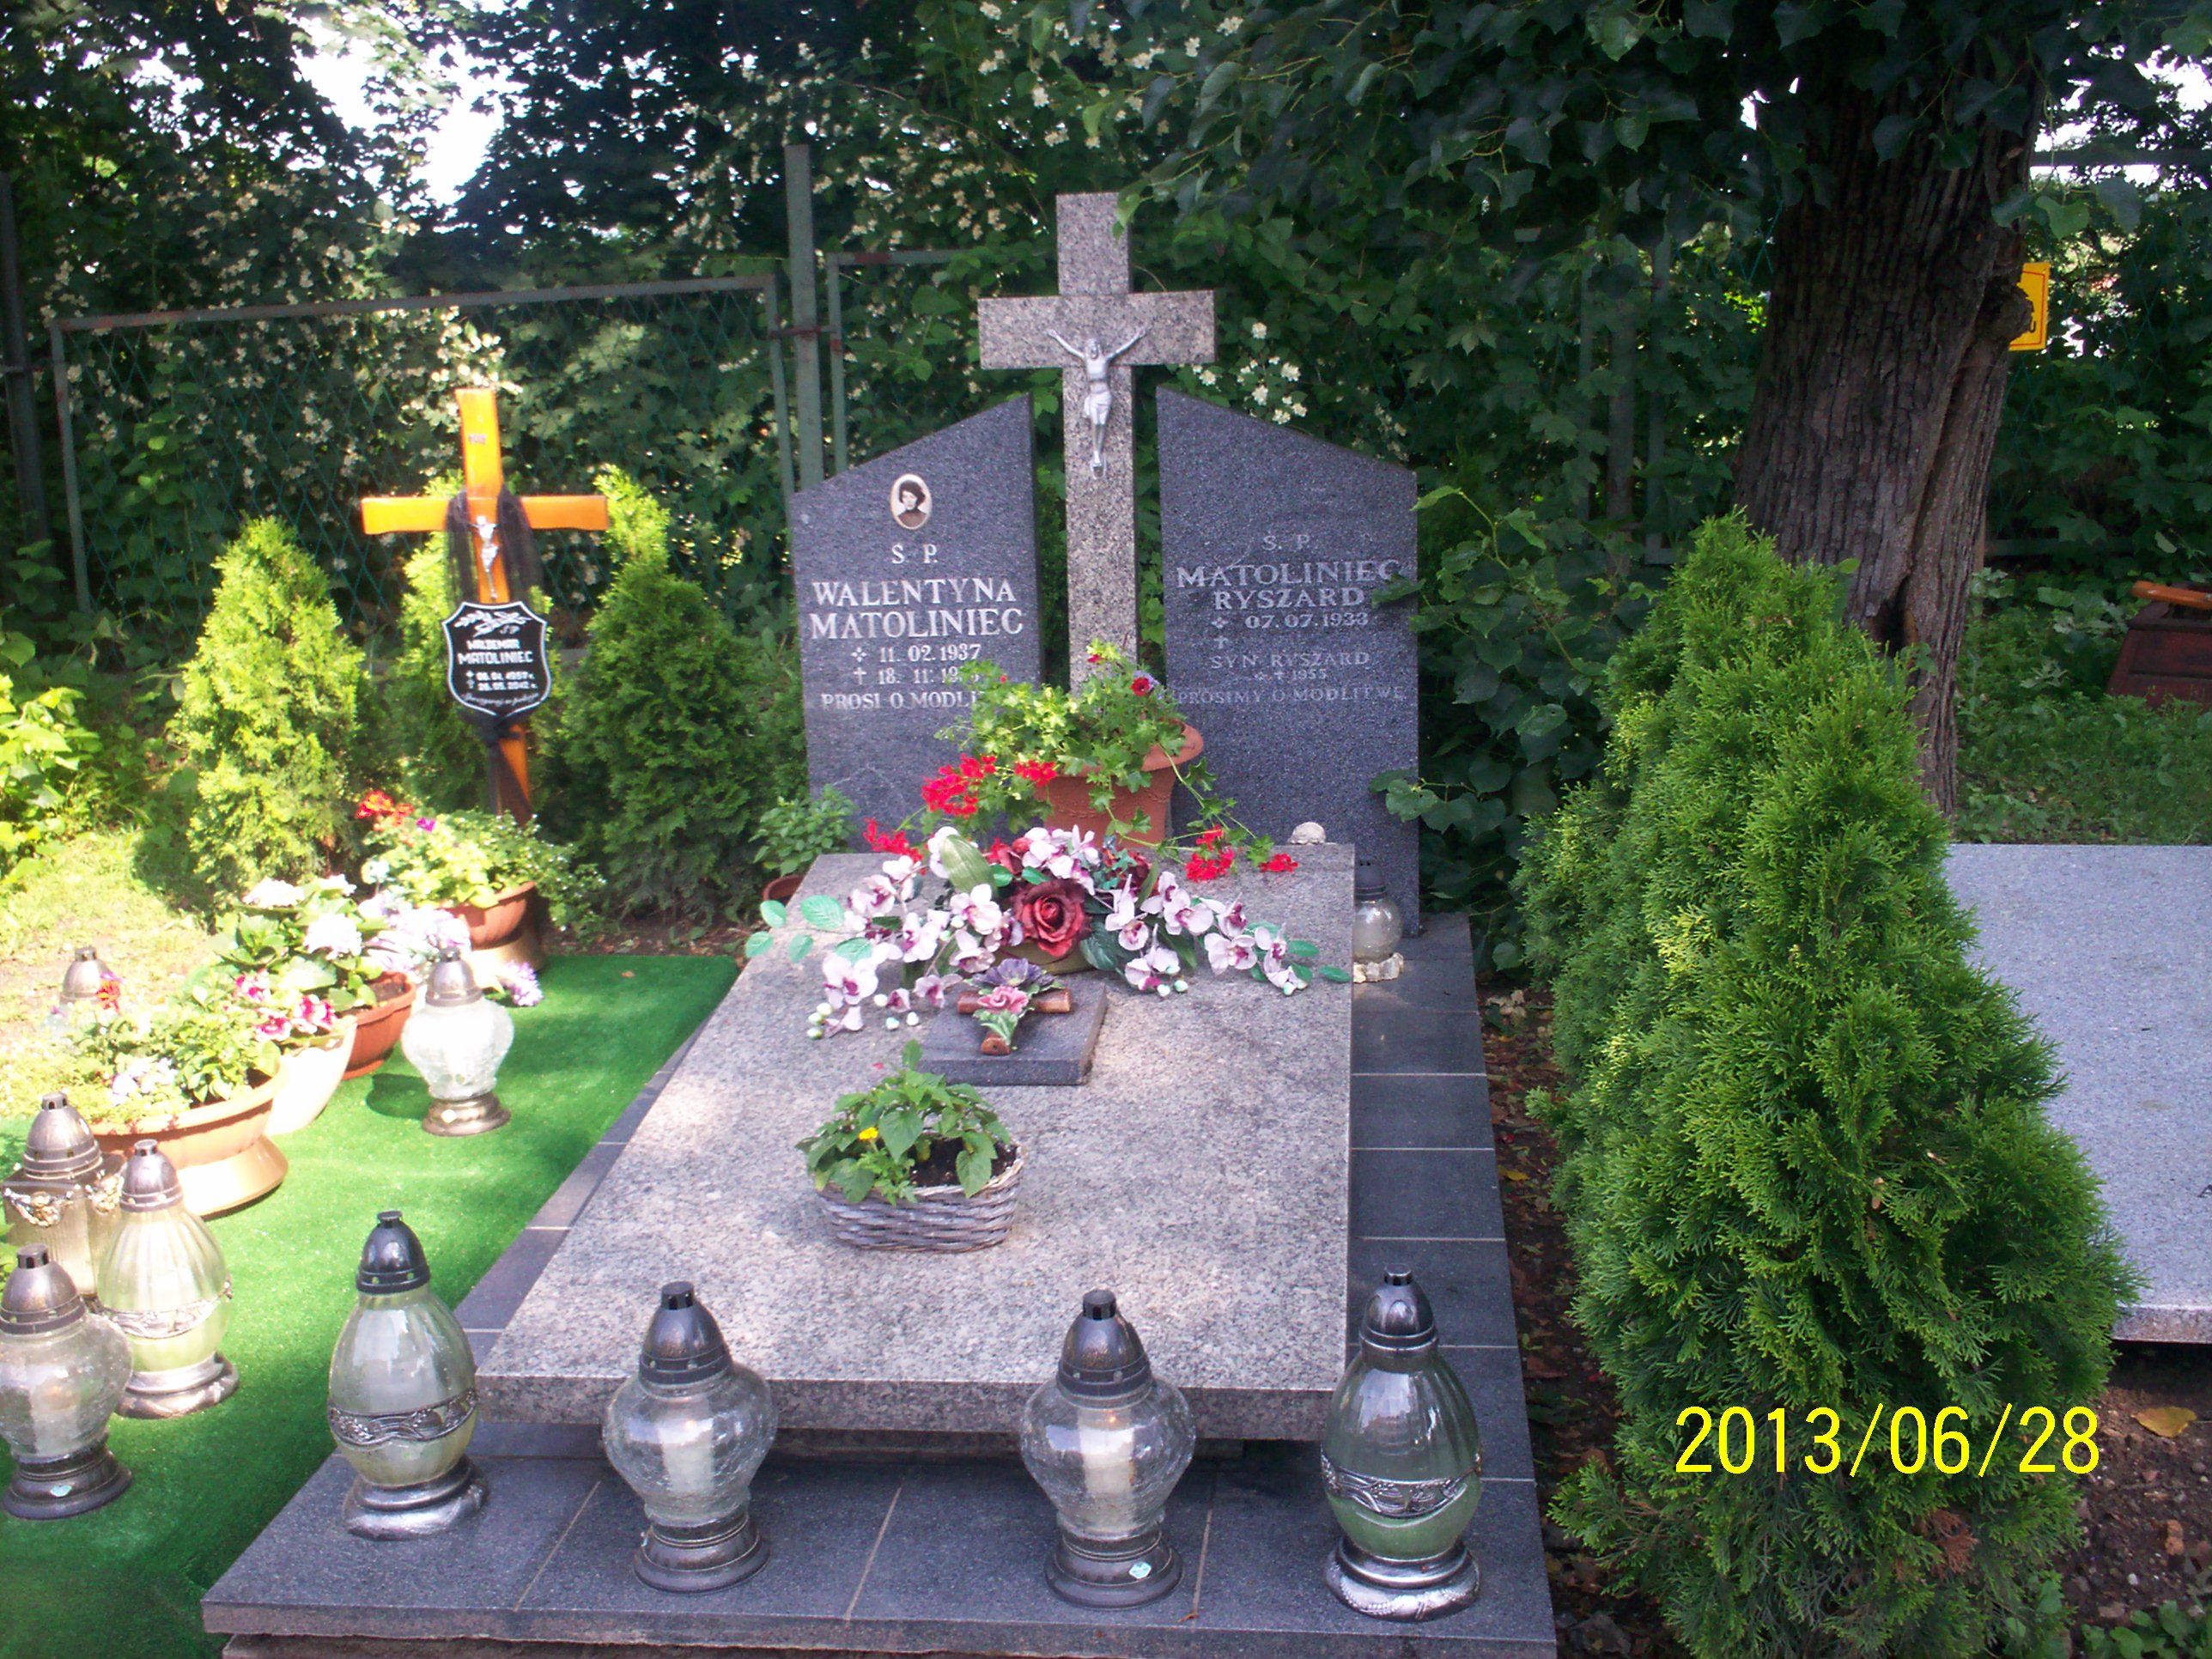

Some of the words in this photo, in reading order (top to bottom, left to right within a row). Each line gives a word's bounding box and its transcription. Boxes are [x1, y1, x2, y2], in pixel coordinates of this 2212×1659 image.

[1176, 559, 1399, 587] MATOLINIEC
[812, 577, 1017, 606] WALENTYNA
[1214, 586, 1365, 610] RYSZARD
[809, 608, 1024, 639] MATOLINIEC
[457, 651, 533, 665] MATOLINIEC
[1210, 654, 1258, 670] SYN
[1271, 652, 1370, 667] RYSZARD
[890, 693, 902, 709] O
[1272, 689, 1285, 702] O
